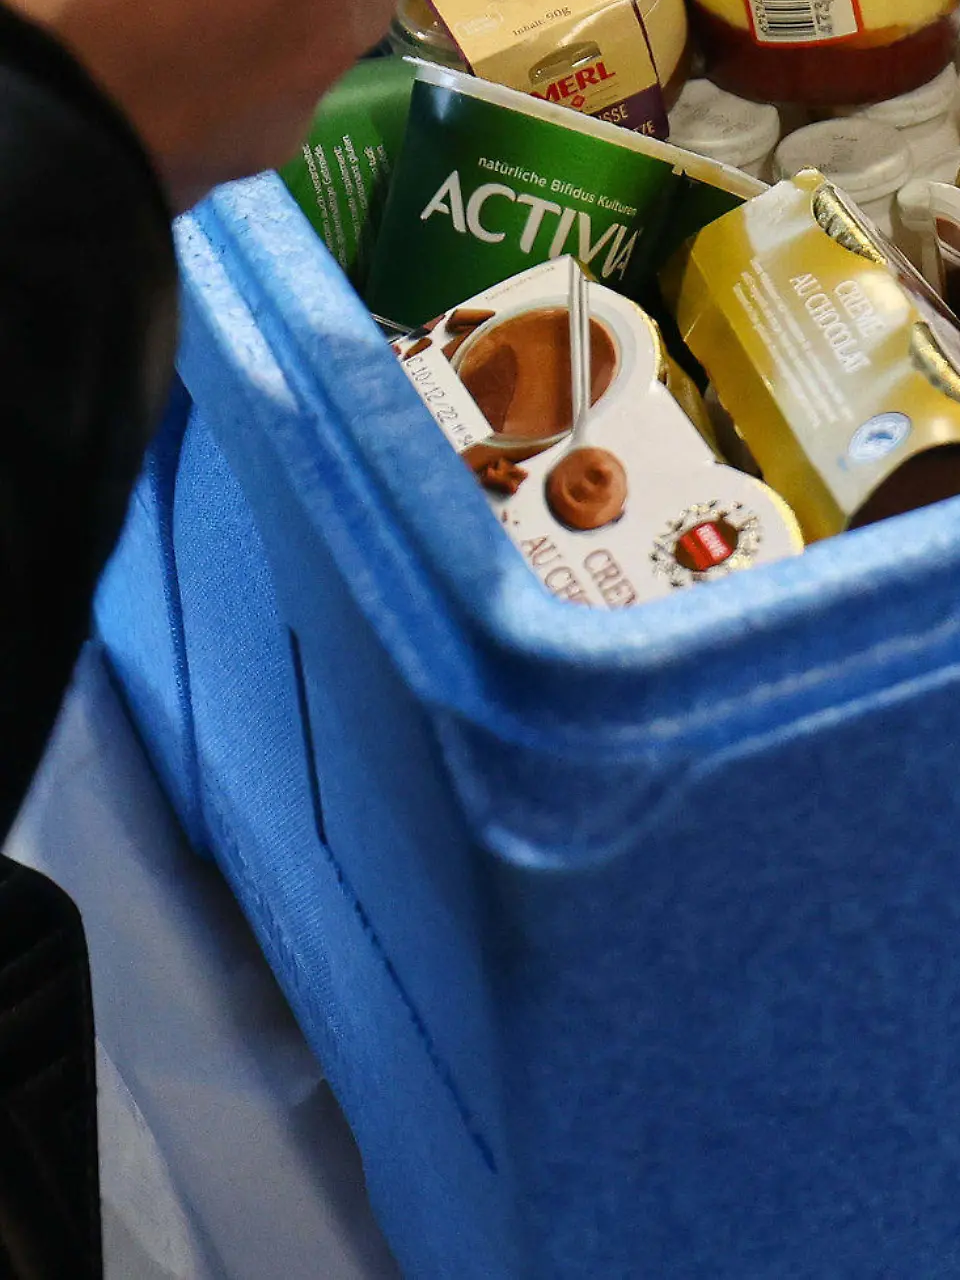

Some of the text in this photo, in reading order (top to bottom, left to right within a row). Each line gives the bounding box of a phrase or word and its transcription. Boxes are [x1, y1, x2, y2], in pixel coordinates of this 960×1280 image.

[477, 156, 547, 189] natürliche
[550, 179, 596, 205] Bifidus
[804, 292, 872, 373] CHOCOLAT
